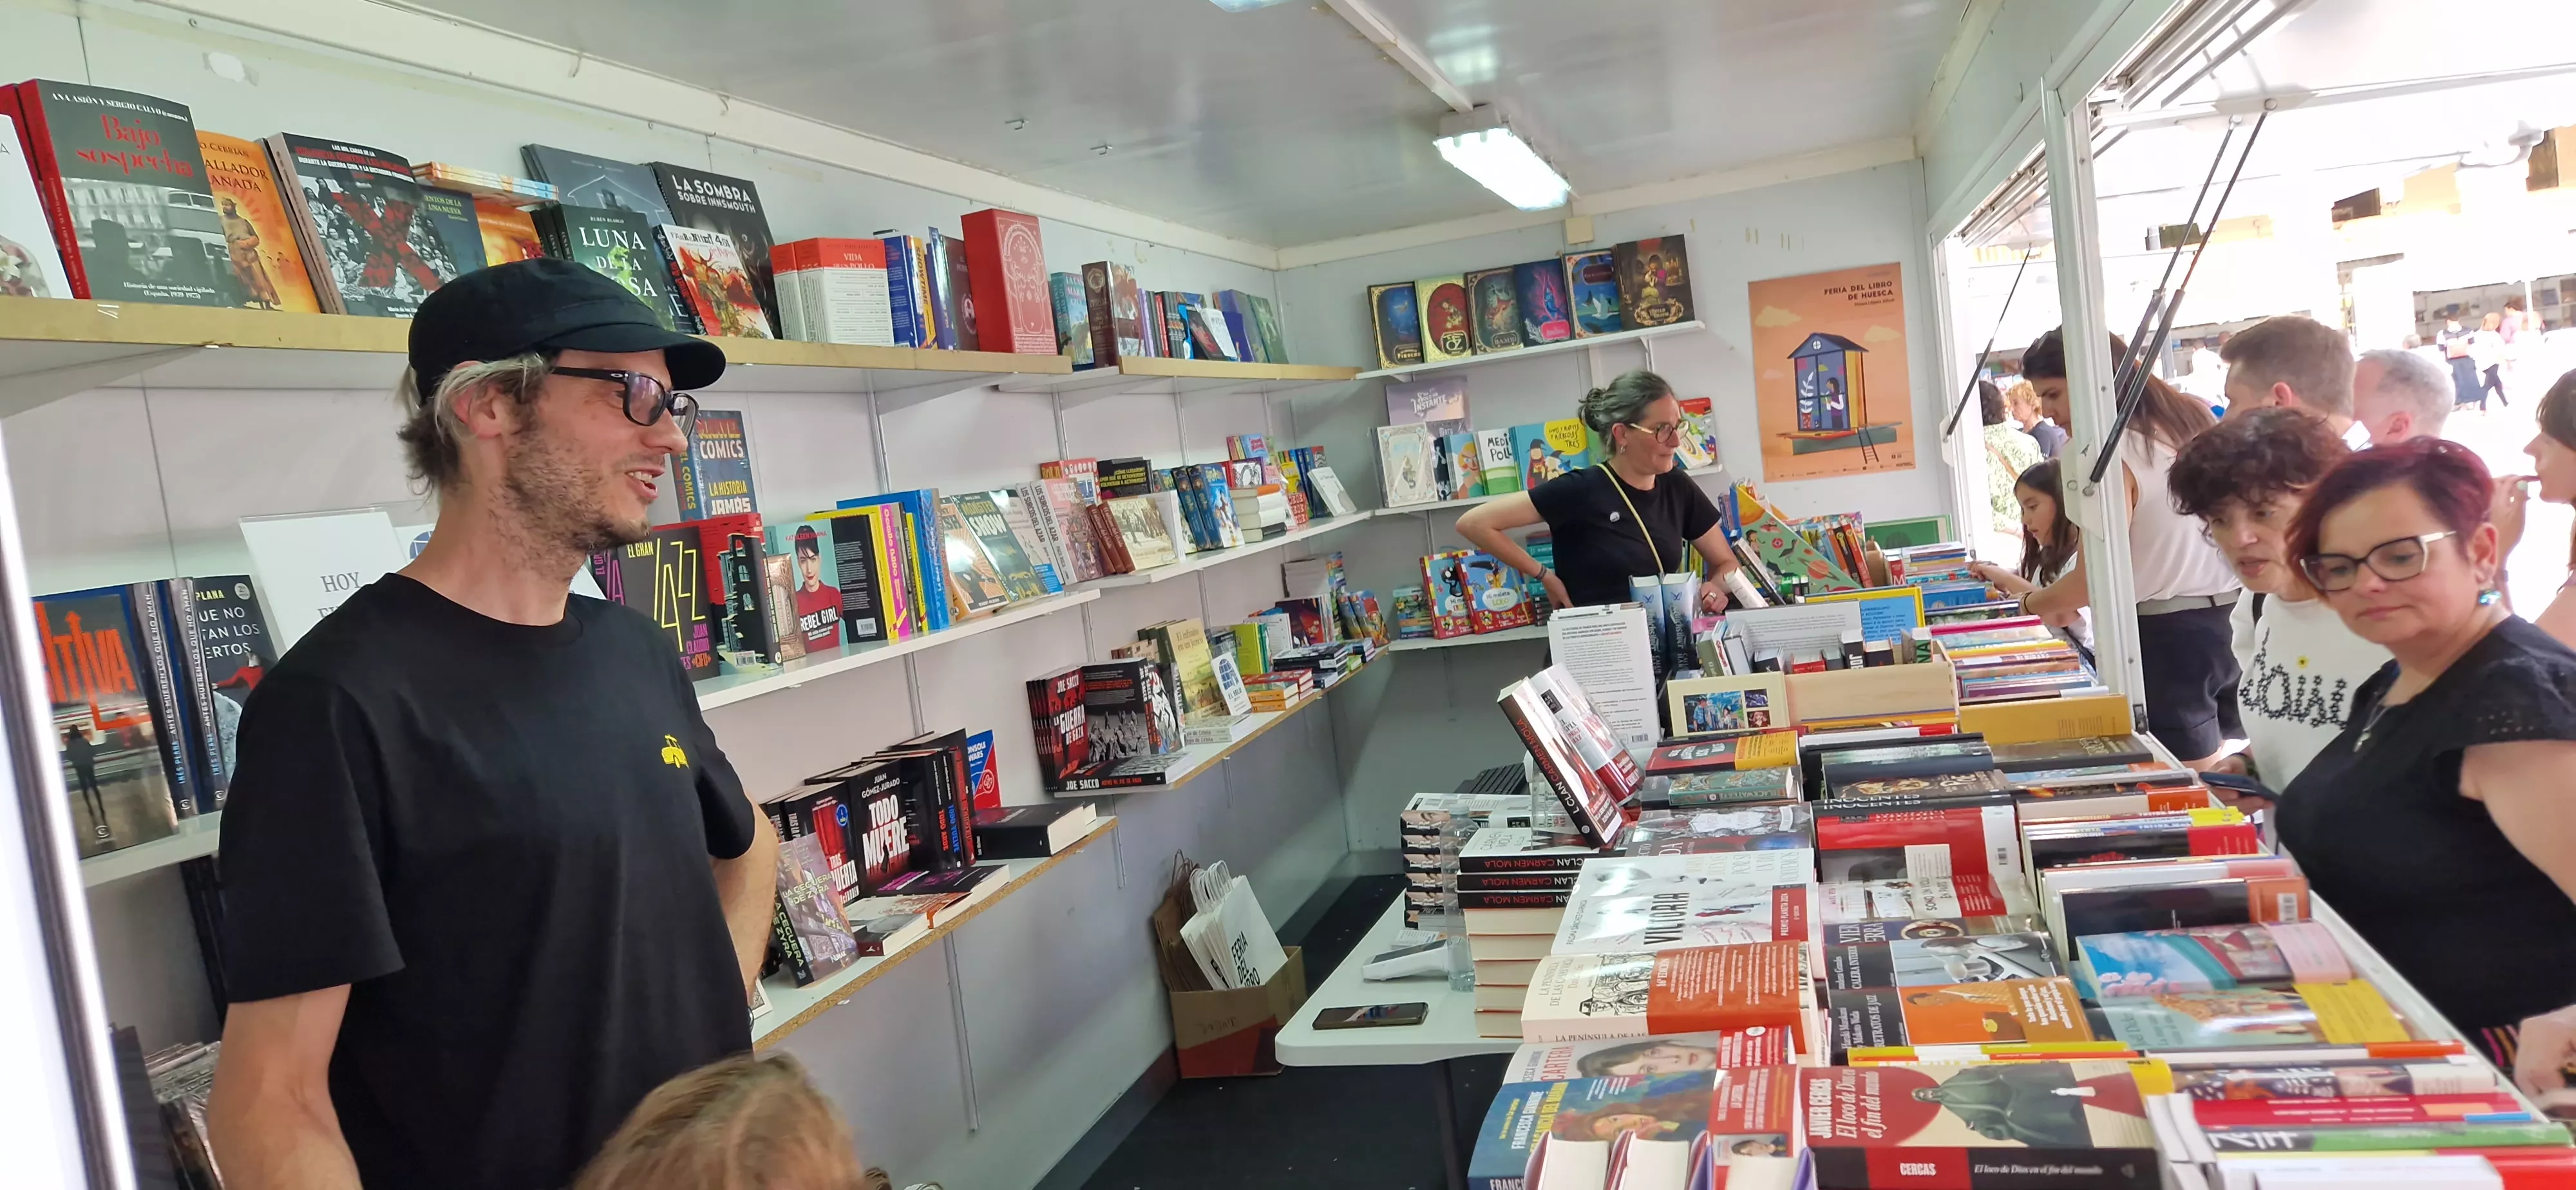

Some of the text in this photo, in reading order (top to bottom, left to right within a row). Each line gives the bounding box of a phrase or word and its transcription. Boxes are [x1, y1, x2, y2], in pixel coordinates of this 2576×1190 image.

[106, 99, 137, 111] SERGIO
[100, 113, 160, 151] Bajo
[75, 148, 194, 178] sospecha
[205, 158, 269, 181] ALLADOR
[211, 175, 263, 193] ANADA
[672, 175, 752, 204] LA SOMBRA
[677, 192, 757, 214] SOBRE INNSMOUTH
[579, 227, 647, 252] LUNA
[596, 255, 643, 272] DE LA
[843, 253, 864, 262] VIDA
[915, 246, 929, 305] SHOWTIME
[1824, 286, 1847, 295] FERIA
[1868, 280, 1893, 289] LIBRO
[1861, 289, 1893, 299] HUESCA
[1410, 394, 1446, 413] INSTANTE
[699, 440, 745, 459] COMICS
[1488, 433, 1510, 448] MEDI
[1564, 440, 1580, 449] TRES
[1490, 447, 1513, 462] POLL
[682, 466, 696, 510] COMICS
[709, 480, 748, 496] LA HISTORIA
[712, 496, 752, 515] JAMÁS
[1024, 496, 1037, 519] SURCOS
[1038, 495, 1050, 519] SURCOS
[969, 513, 1007, 537] SHOW
[1031, 516, 1040, 528] DEL
[1045, 516, 1054, 527] DEL
[785, 531, 828, 542] KATHLEEN HANNA
[1035, 526, 1046, 543] AZAR
[1049, 525, 1059, 543] AZAR
[627, 541, 654, 558] EL GRAN
[319, 572, 362, 592] HOY
[195, 589, 225, 601] PLANA
[653, 538, 706, 652] JAZZ
[1493, 590, 1510, 599] maleta
[223, 607, 245, 620] NO
[800, 607, 839, 632] REBEL GIRL
[233, 623, 260, 637] LOS
[693, 623, 708, 639] JUAN
[1176, 632, 1182, 642] El
[205, 642, 252, 659] ERTOS
[687, 638, 710, 655] CLAUDIO
[182, 589, 217, 756] PLANA ANTES MUEREN LOS QUE NO AMAN
[144, 594, 186, 785] INÉS PLANA ANTES MUEREN LOS QUE NO AMAN
[1057, 674, 1079, 694] JOE SACCO
[1054, 716, 1061, 726] LA
[1059, 703, 1086, 734] GUERRA
[1066, 724, 1084, 745] DE GAZA
[969, 751, 984, 762] WARS
[1516, 719, 1575, 806] CLAN CARMEN MOLA
[861, 777, 900, 798] GÓMEZ-JURADO
[873, 773, 887, 784] JUAN
[1066, 778, 1099, 791] JOE SACCO
[788, 813, 798, 828] TRAS
[868, 793, 899, 829] TODO
[938, 809, 949, 852] TODO ARDE
[948, 804, 961, 854] TODO VUELVE
[862, 815, 910, 870] MUERE
[829, 853, 842, 869] TRAS
[1513, 859, 1555, 867] CARMEN
[831, 860, 858, 892] UERTA
[1511, 878, 1553, 886] CARMEN
[782, 874, 833, 899] LA CEGUERA
[794, 884, 830, 905] DE ZYRA
[1482, 896, 1554, 905] CARMEN MOLA
[1643, 891, 1691, 945] VICTORIA
[1780, 903, 1789, 936] PREMIO PLANETA
[776, 925, 793, 959] ZYRA
[779, 912, 804, 967] CEGUERA
[1231, 930, 1248, 966] FERIA
[1237, 961, 1250, 984] DEL
[1850, 963, 1862, 989] CALERA
[1539, 988, 1549, 996] LA
[1550, 985, 1563, 1006] DE LAS
[1838, 1007, 1850, 1030] Murakami
[1866, 995, 1886, 1048] RETRATOS DE JAZZ
[1540, 1044, 1575, 1082] CARTERA
[1860, 1072, 1880, 1113] del mundo
[1808, 1078, 1832, 1138] JAVIER CERCAS
[1837, 1076, 1857, 1138] El loco de Dios
[1511, 1115, 1534, 1149] FRANCESCA
[1899, 1163, 1936, 1176] CERCAS
[1975, 1164, 2029, 1175] El loco de Dios
